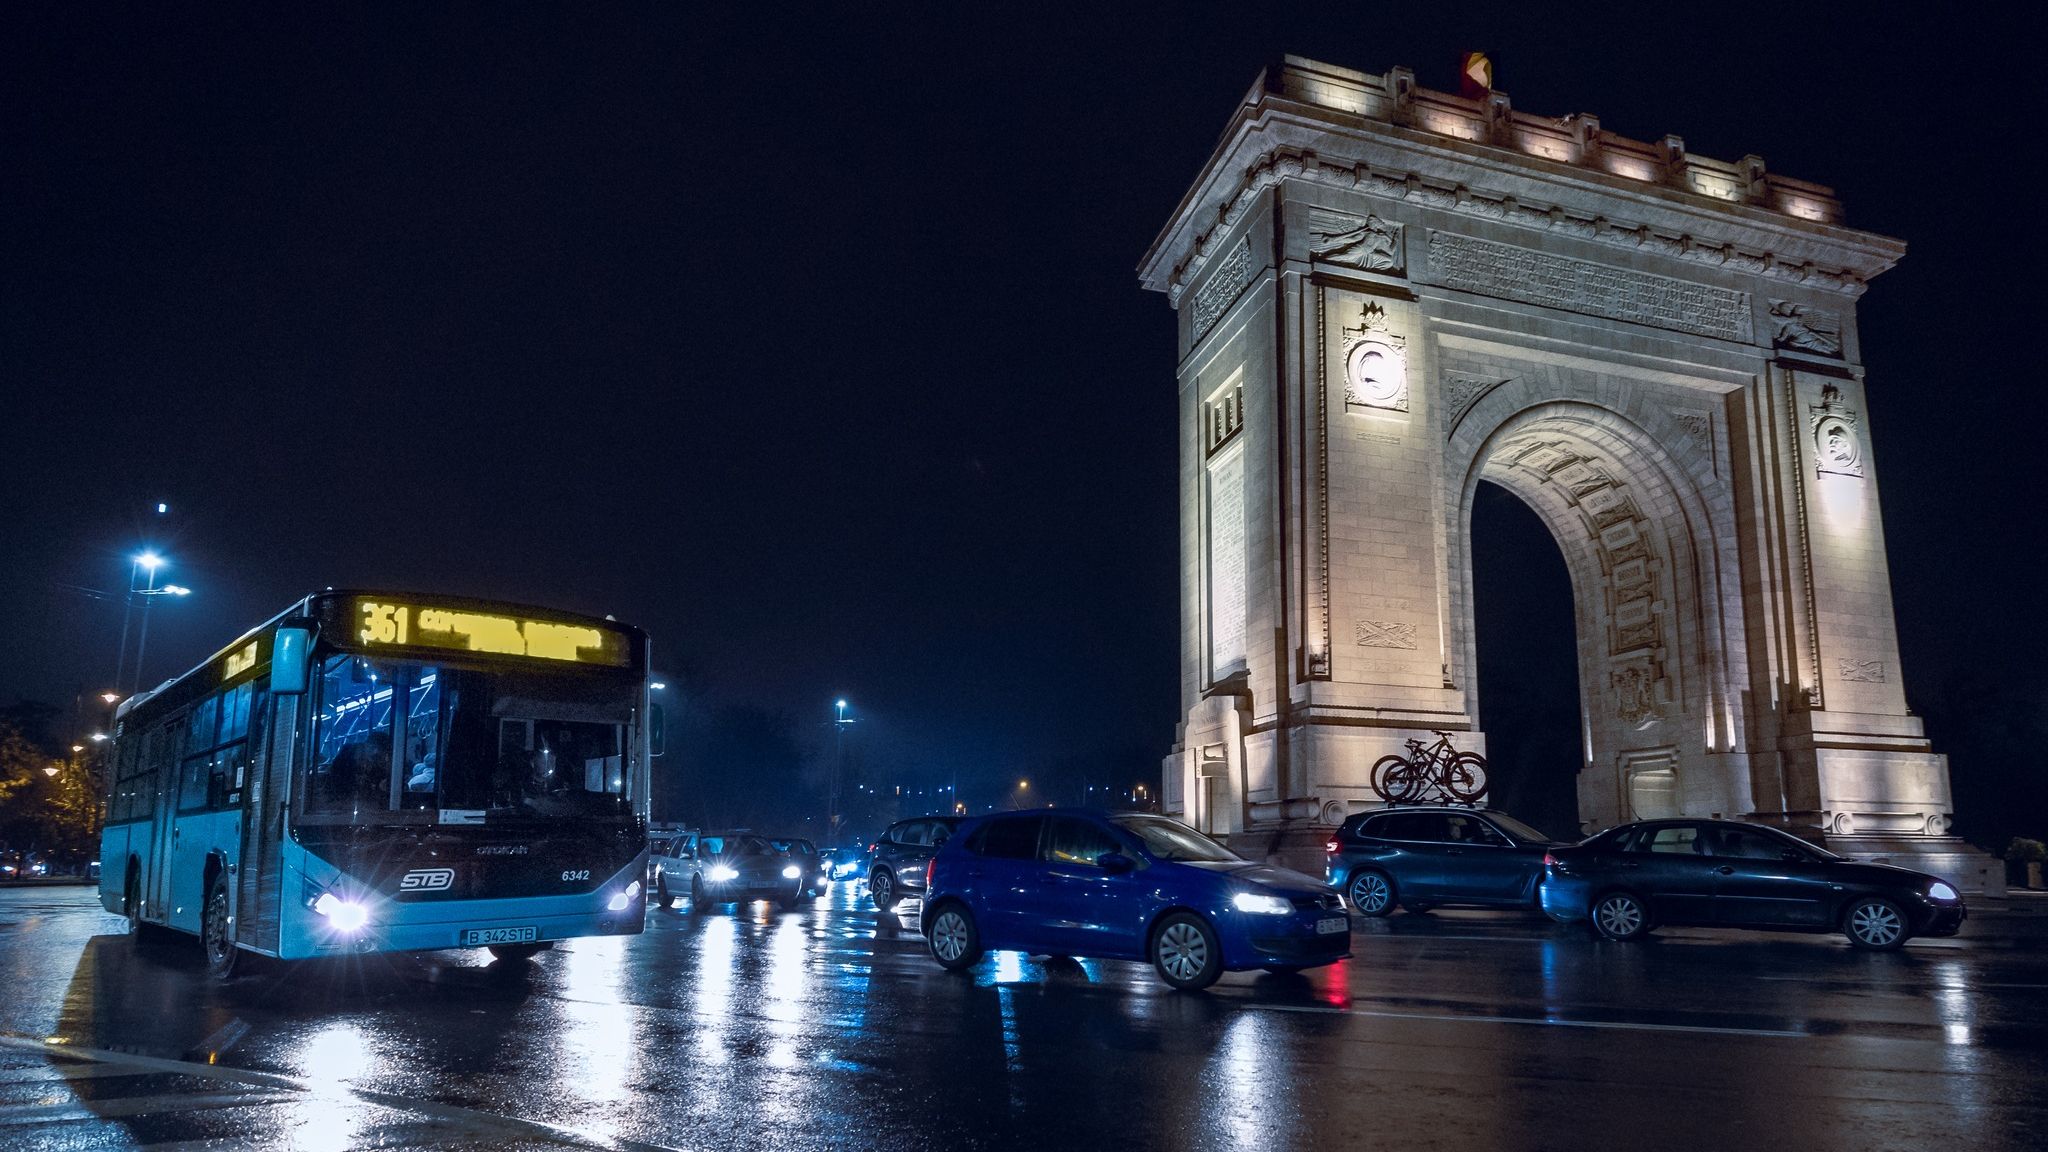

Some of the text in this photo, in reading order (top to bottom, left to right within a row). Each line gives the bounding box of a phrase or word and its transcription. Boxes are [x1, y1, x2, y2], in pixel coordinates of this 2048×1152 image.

[400, 871, 451, 889] STB
[560, 869, 590, 882] 6342
[469, 930, 478, 943] B
